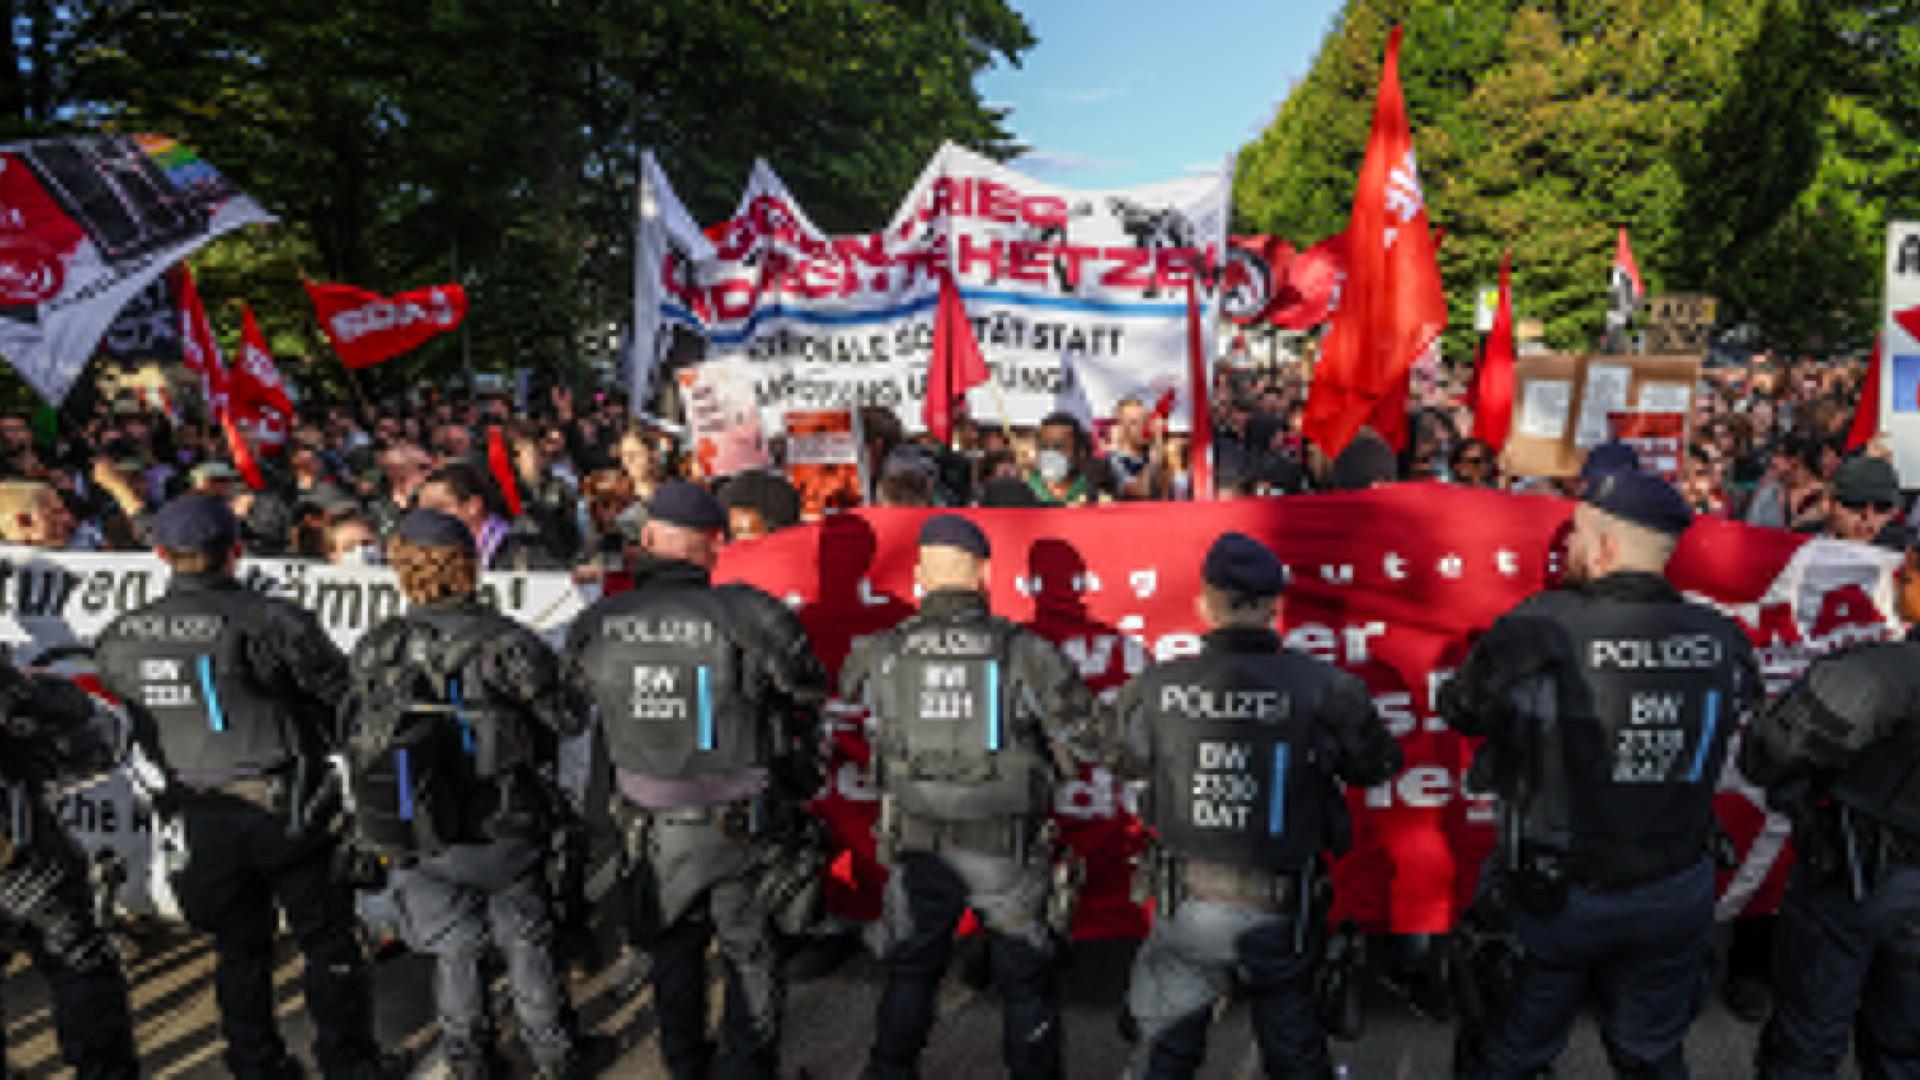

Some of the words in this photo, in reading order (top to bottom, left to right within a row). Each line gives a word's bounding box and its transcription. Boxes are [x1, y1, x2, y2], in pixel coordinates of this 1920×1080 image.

[602, 617, 713, 646] POLIZEI
[1590, 636, 1722, 668] POLIZEI
[1160, 685, 1290, 719] POLIZEI
